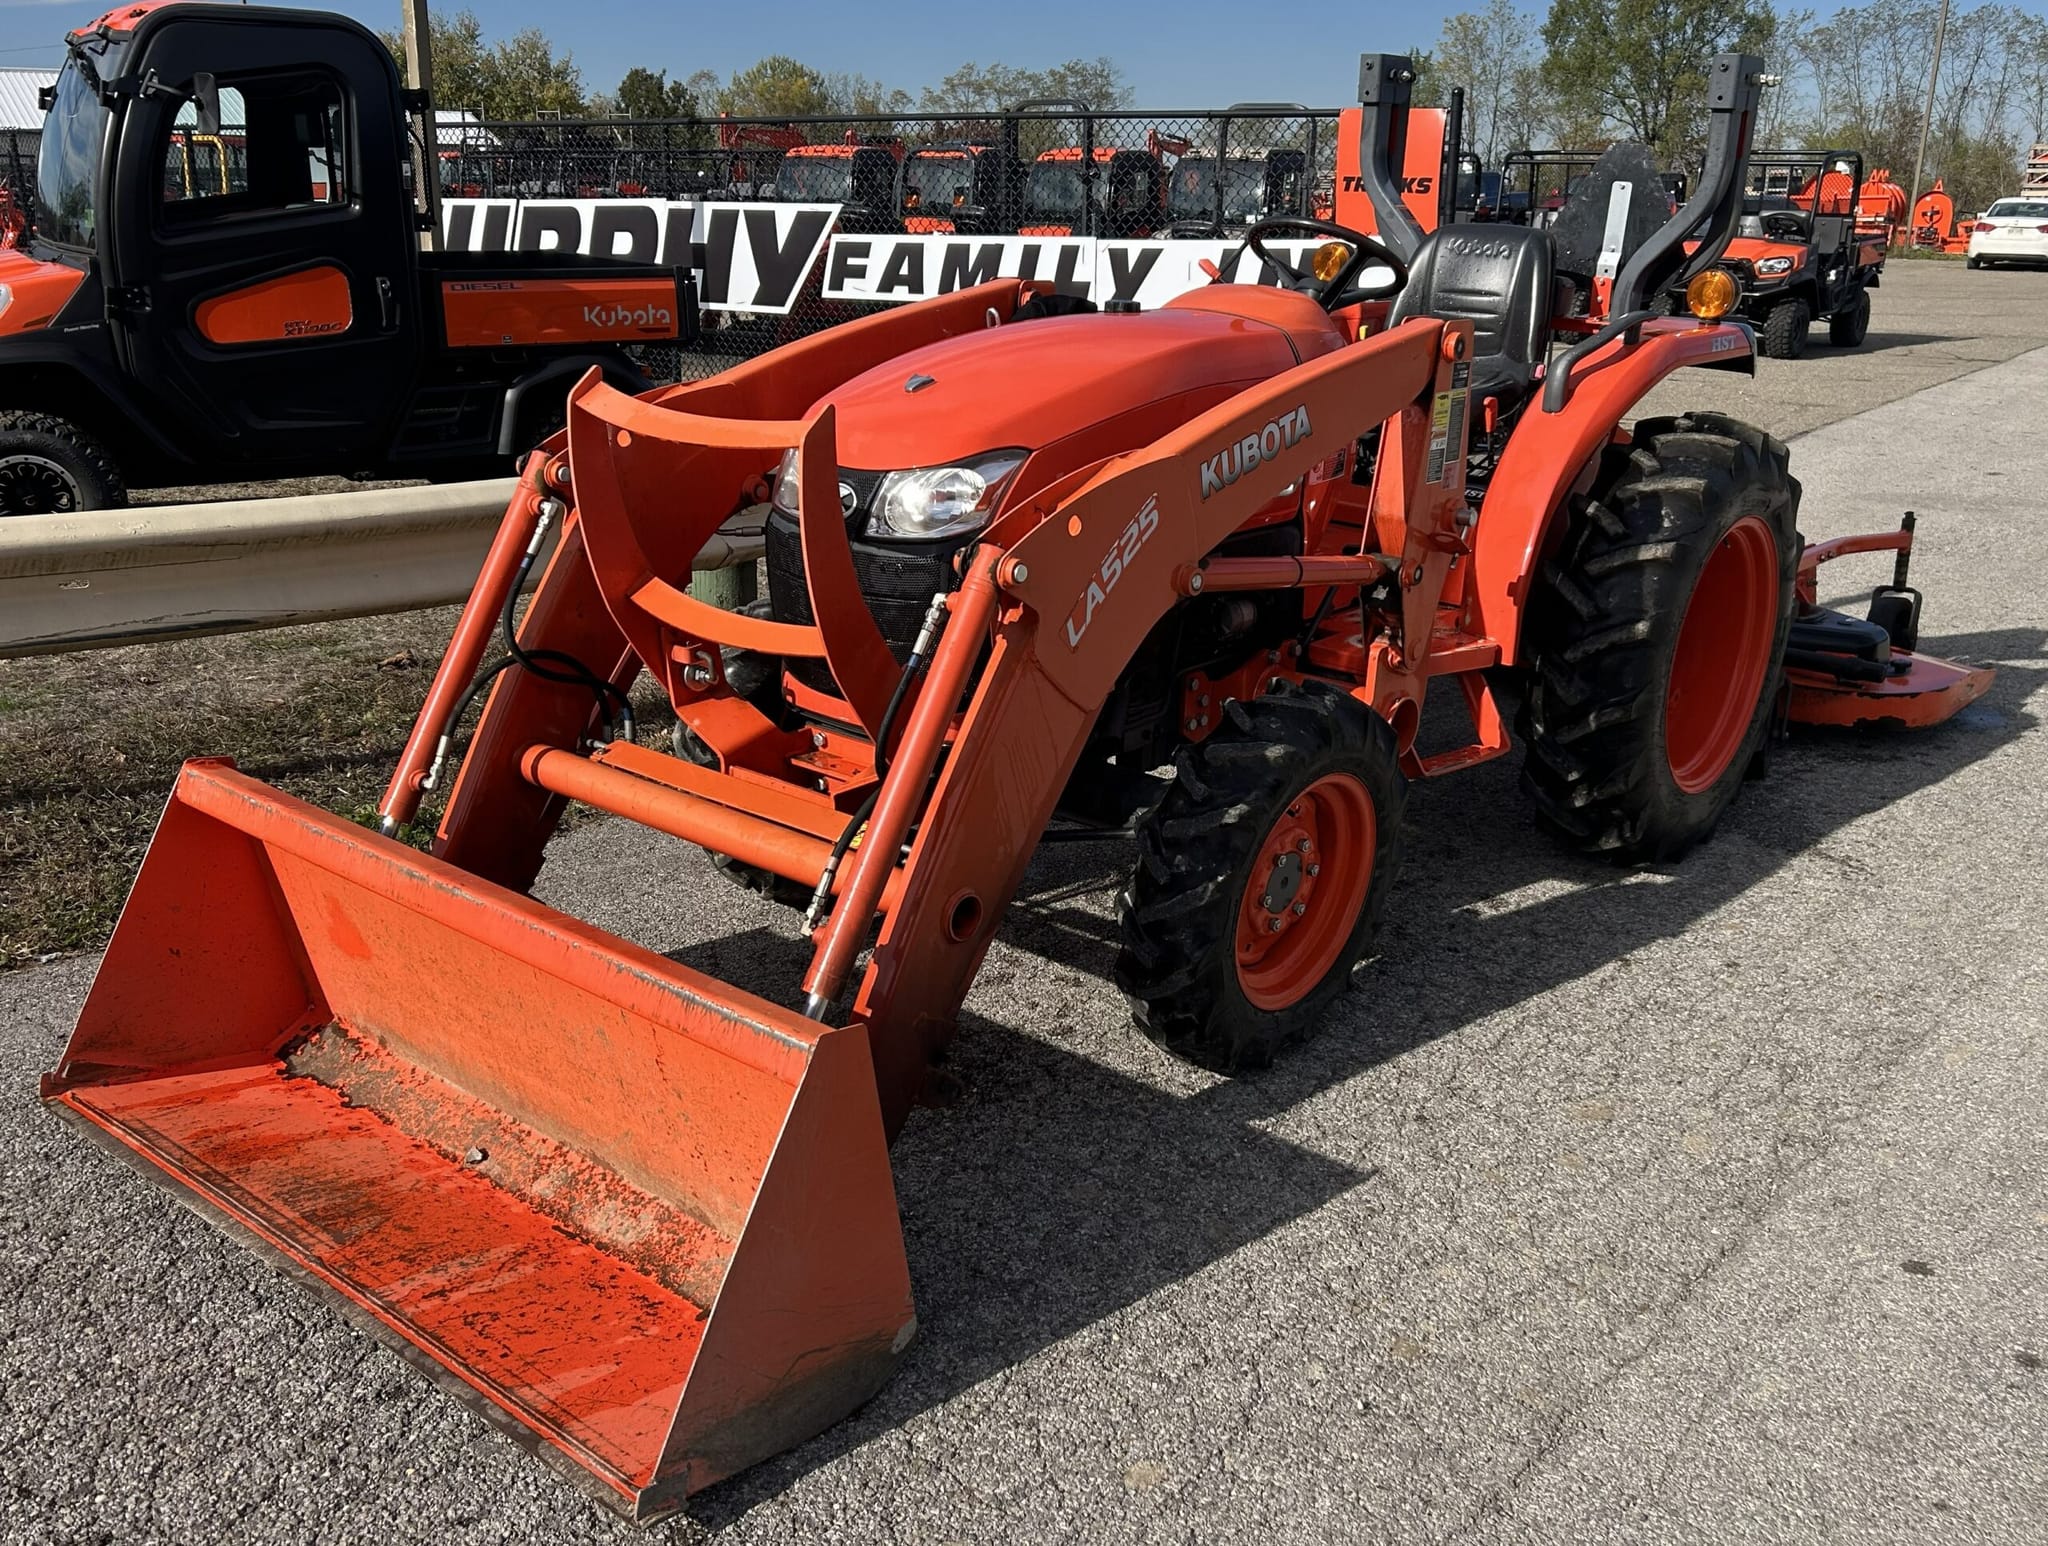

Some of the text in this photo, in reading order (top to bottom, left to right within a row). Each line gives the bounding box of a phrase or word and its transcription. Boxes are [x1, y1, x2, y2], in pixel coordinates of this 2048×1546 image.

[1342, 176, 1433, 194] TRKS
[828, 241, 1165, 303] FAMILY
[450, 282, 523, 292] DIESEL
[583, 303, 671, 327] Kubota
[1711, 335, 1737, 352] HST
[1199, 403, 1313, 501] KUBOTA
[1066, 497, 1160, 648] LA525
